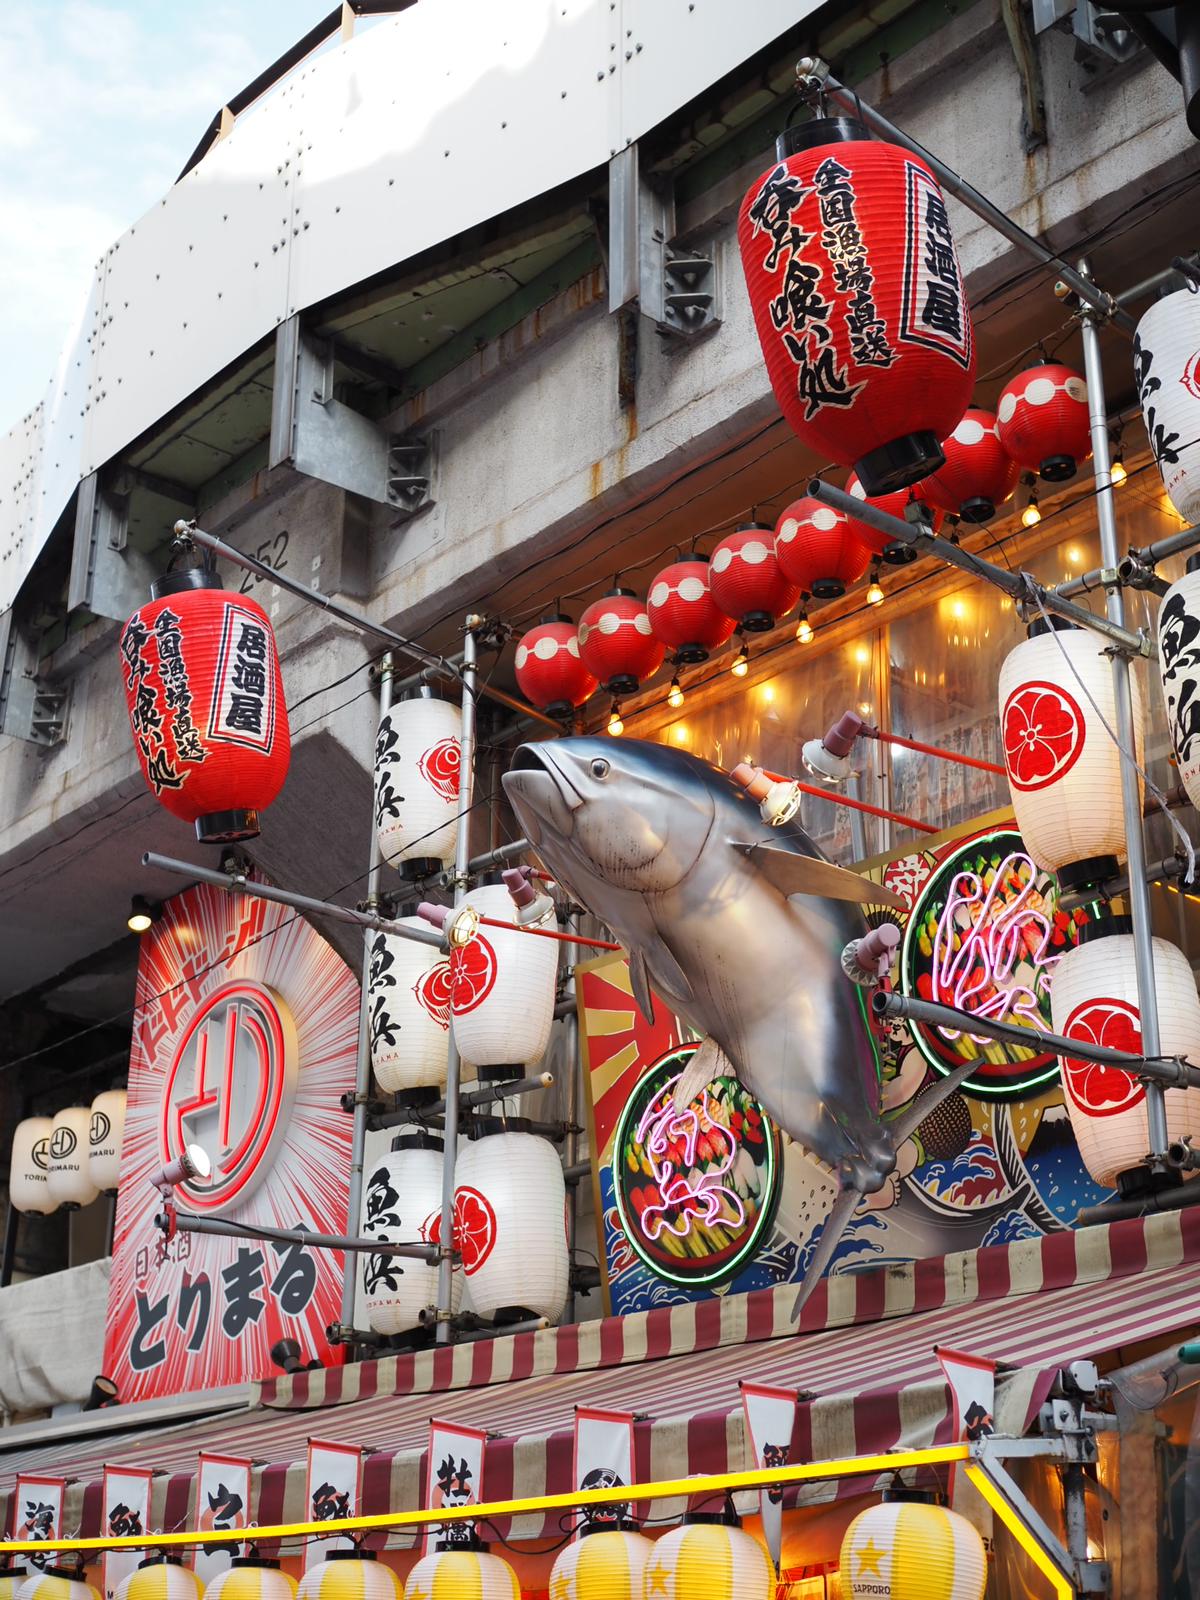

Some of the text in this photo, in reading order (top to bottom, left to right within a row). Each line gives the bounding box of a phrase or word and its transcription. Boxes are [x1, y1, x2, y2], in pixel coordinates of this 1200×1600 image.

[814, 158, 899, 367] 全国漁場直送
[922, 190, 962, 342] 居酒屋
[238, 529, 289, 594] 252
[154, 608, 211, 762] 全国漁場直送
[226, 621, 267, 735] 居酒屋
[129, 1222, 318, 1372] とりまる
[852, 1583, 891, 1595] SAPPORO
